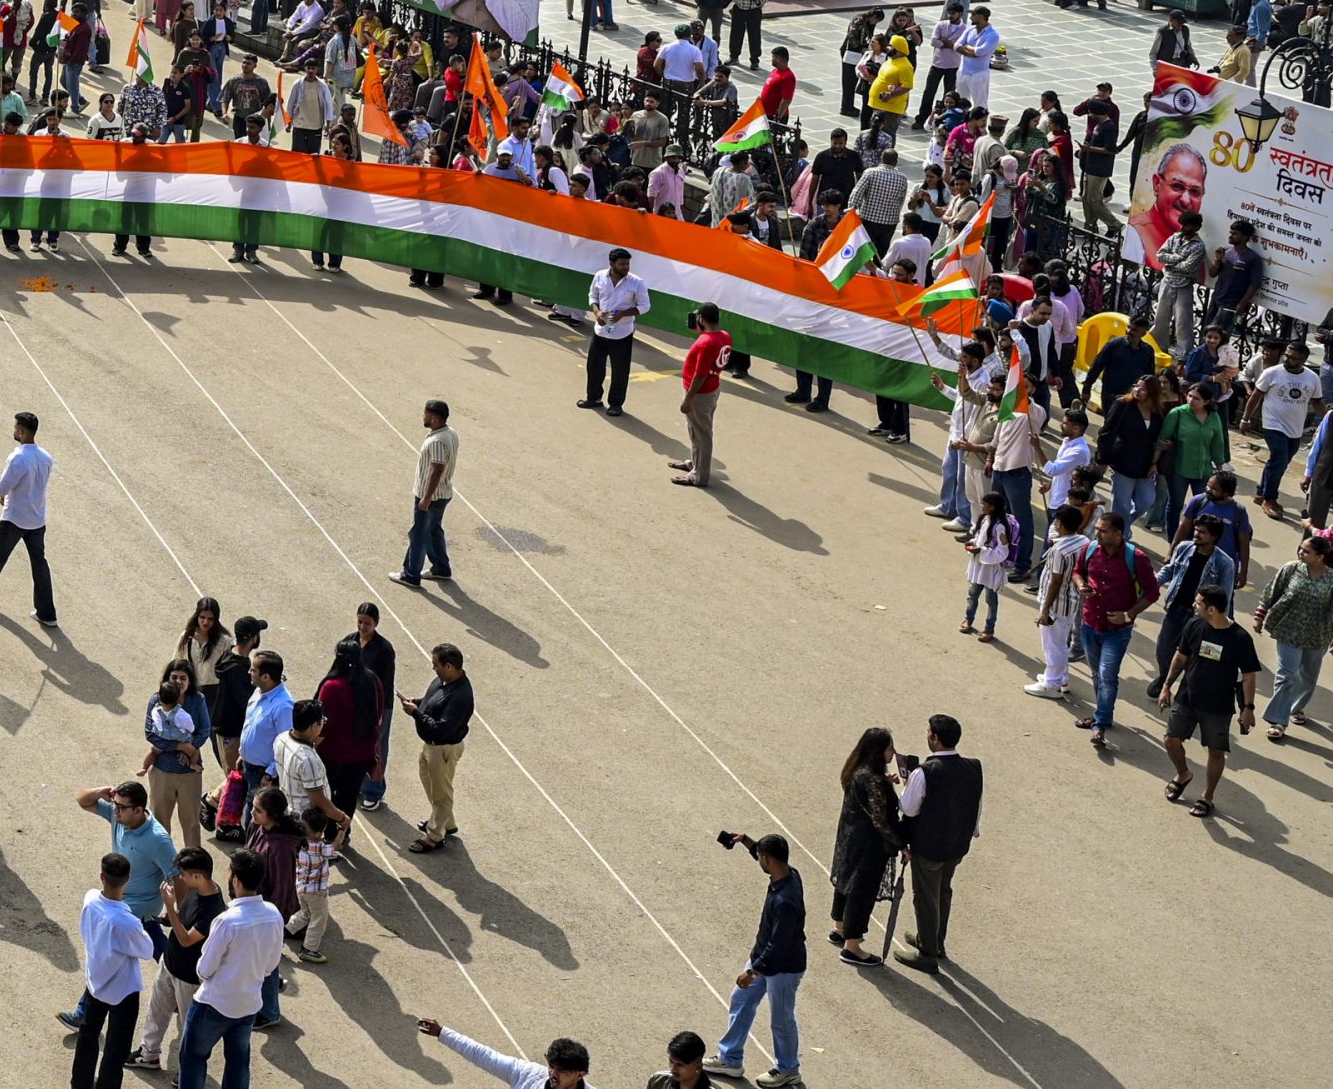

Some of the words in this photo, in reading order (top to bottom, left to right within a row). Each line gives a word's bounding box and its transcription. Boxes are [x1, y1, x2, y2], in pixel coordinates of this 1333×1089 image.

[1209, 131, 1255, 173] 80
[1270, 147, 1333, 185] स्वतंत्रत
[1277, 168, 1325, 204] दिवस
[1256, 207, 1281, 220] स्वतंत्रता
[1283, 213, 1301, 227] दिवस
[1303, 222, 1312, 231] पर
[1267, 223, 1275, 231] की
[1277, 227, 1294, 239] समस्त
[1296, 233, 1313, 243] जनता
[1314, 237, 1322, 247] को
[1272, 279, 1289, 291] गुप्ता
